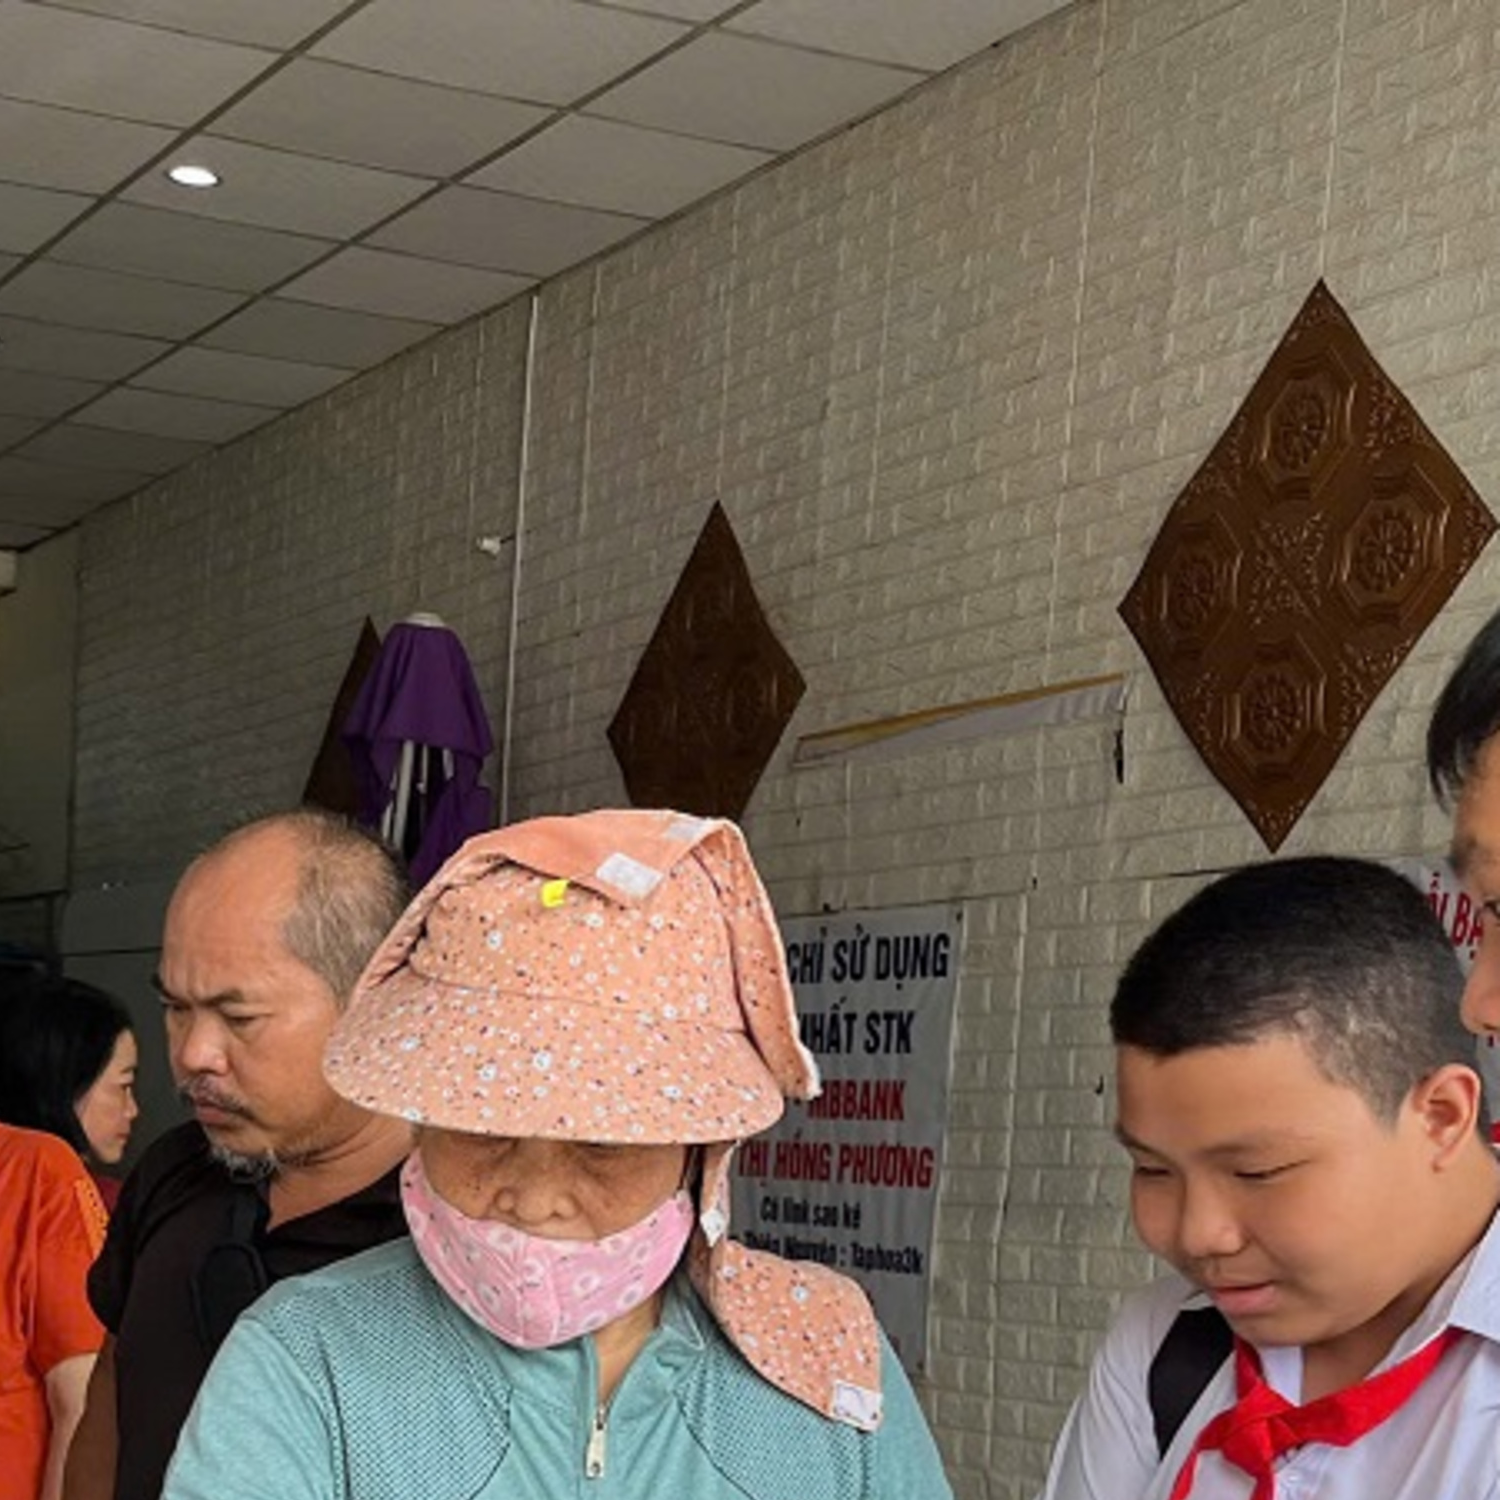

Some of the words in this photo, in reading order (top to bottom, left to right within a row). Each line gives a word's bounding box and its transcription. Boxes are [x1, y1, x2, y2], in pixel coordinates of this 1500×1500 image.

[787, 926, 827, 983] CHỈ
[831, 922, 871, 983] SỬ
[874, 932, 950, 990] DỤNG
[864, 1010, 915, 1054] STK
